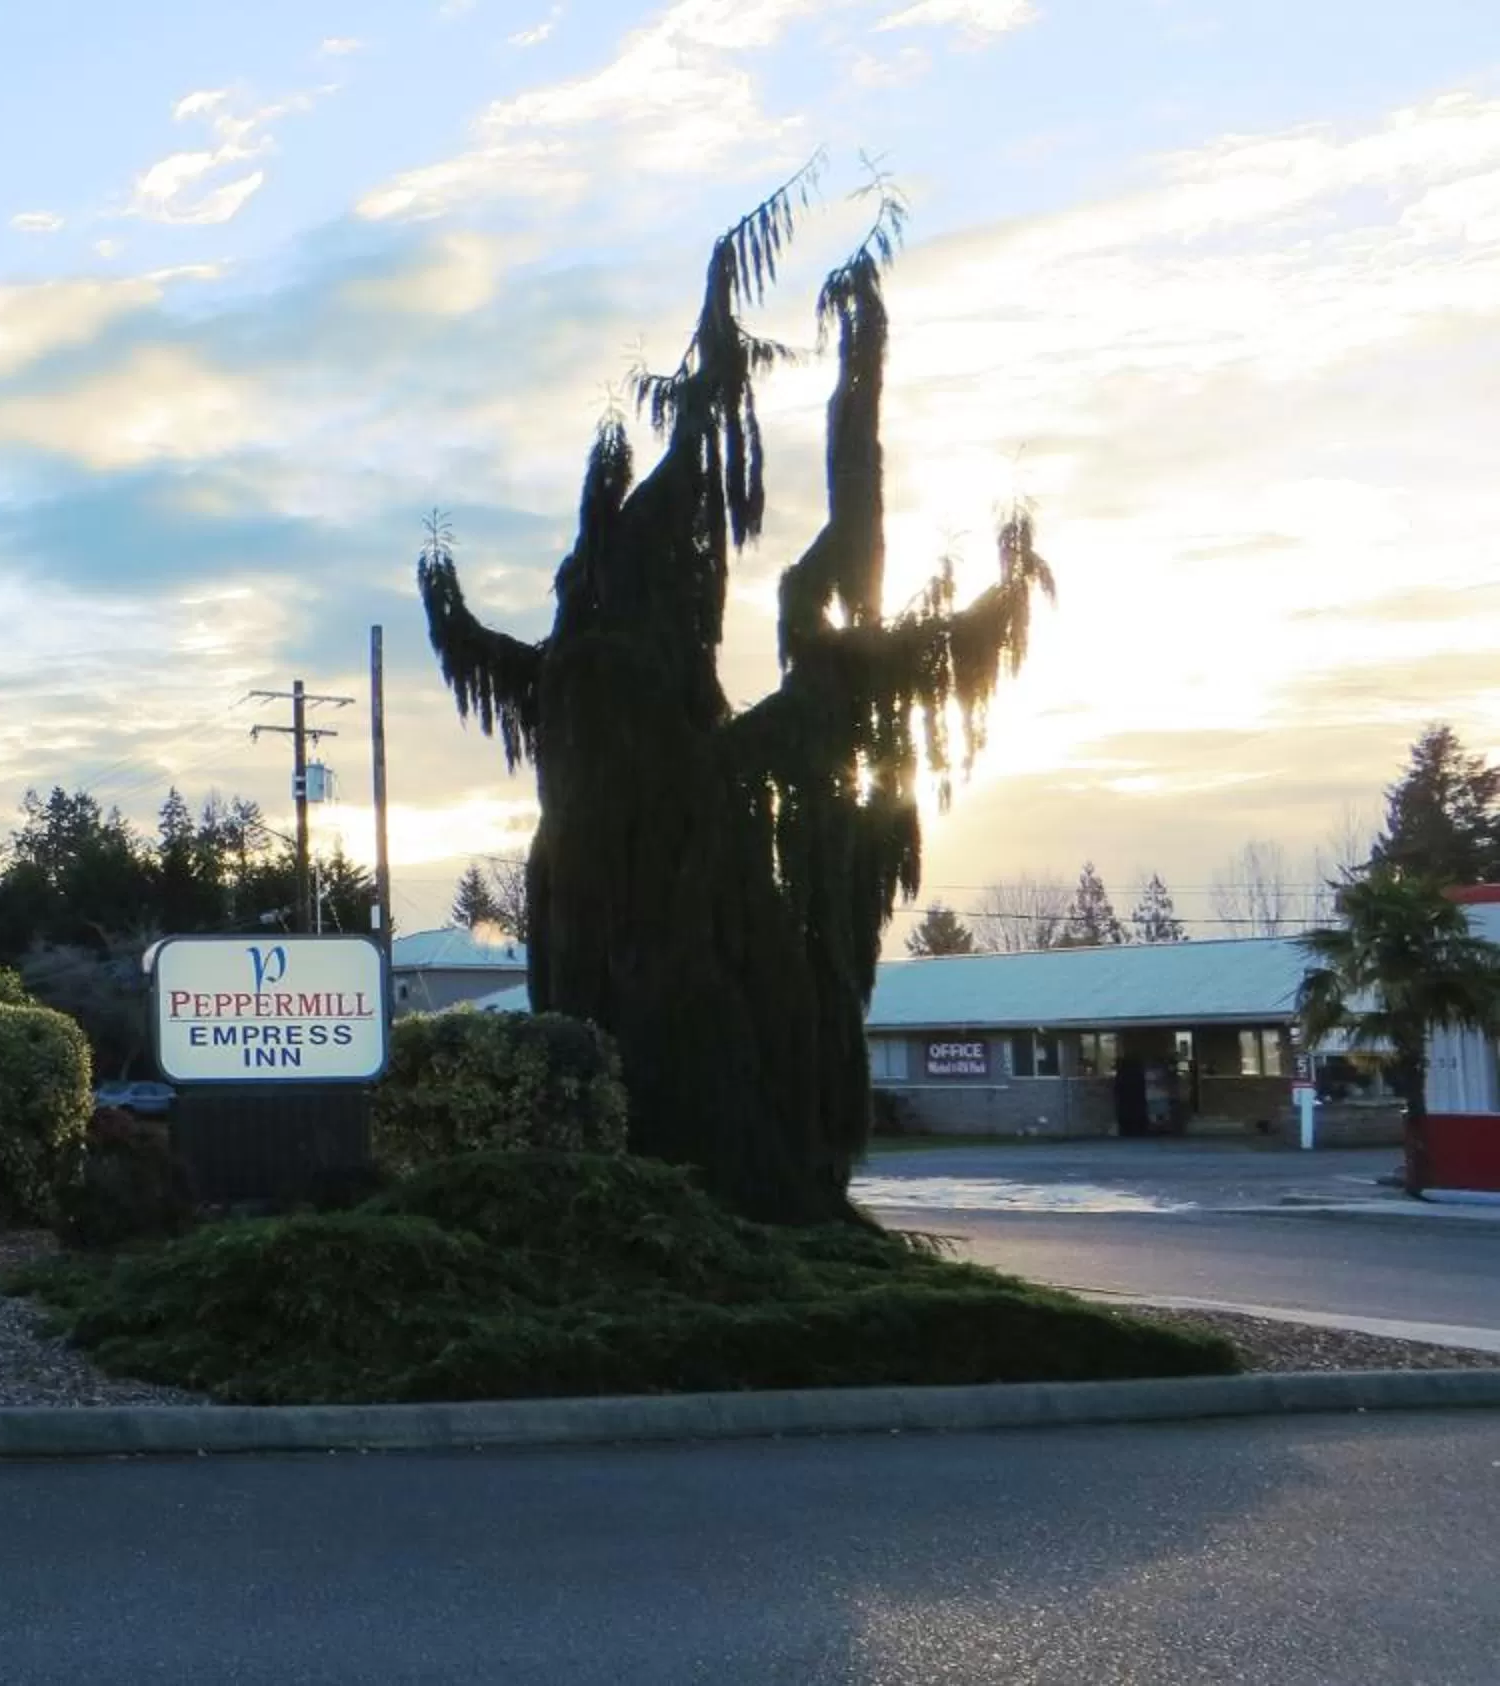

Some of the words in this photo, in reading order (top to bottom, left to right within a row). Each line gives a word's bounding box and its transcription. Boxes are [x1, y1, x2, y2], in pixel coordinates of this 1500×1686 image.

[169, 991, 373, 1017] PEPPERMILL
[189, 1025, 352, 1046] EMPRESS
[244, 1047, 301, 1067] INN
[929, 1043, 984, 1058] OFFICE
